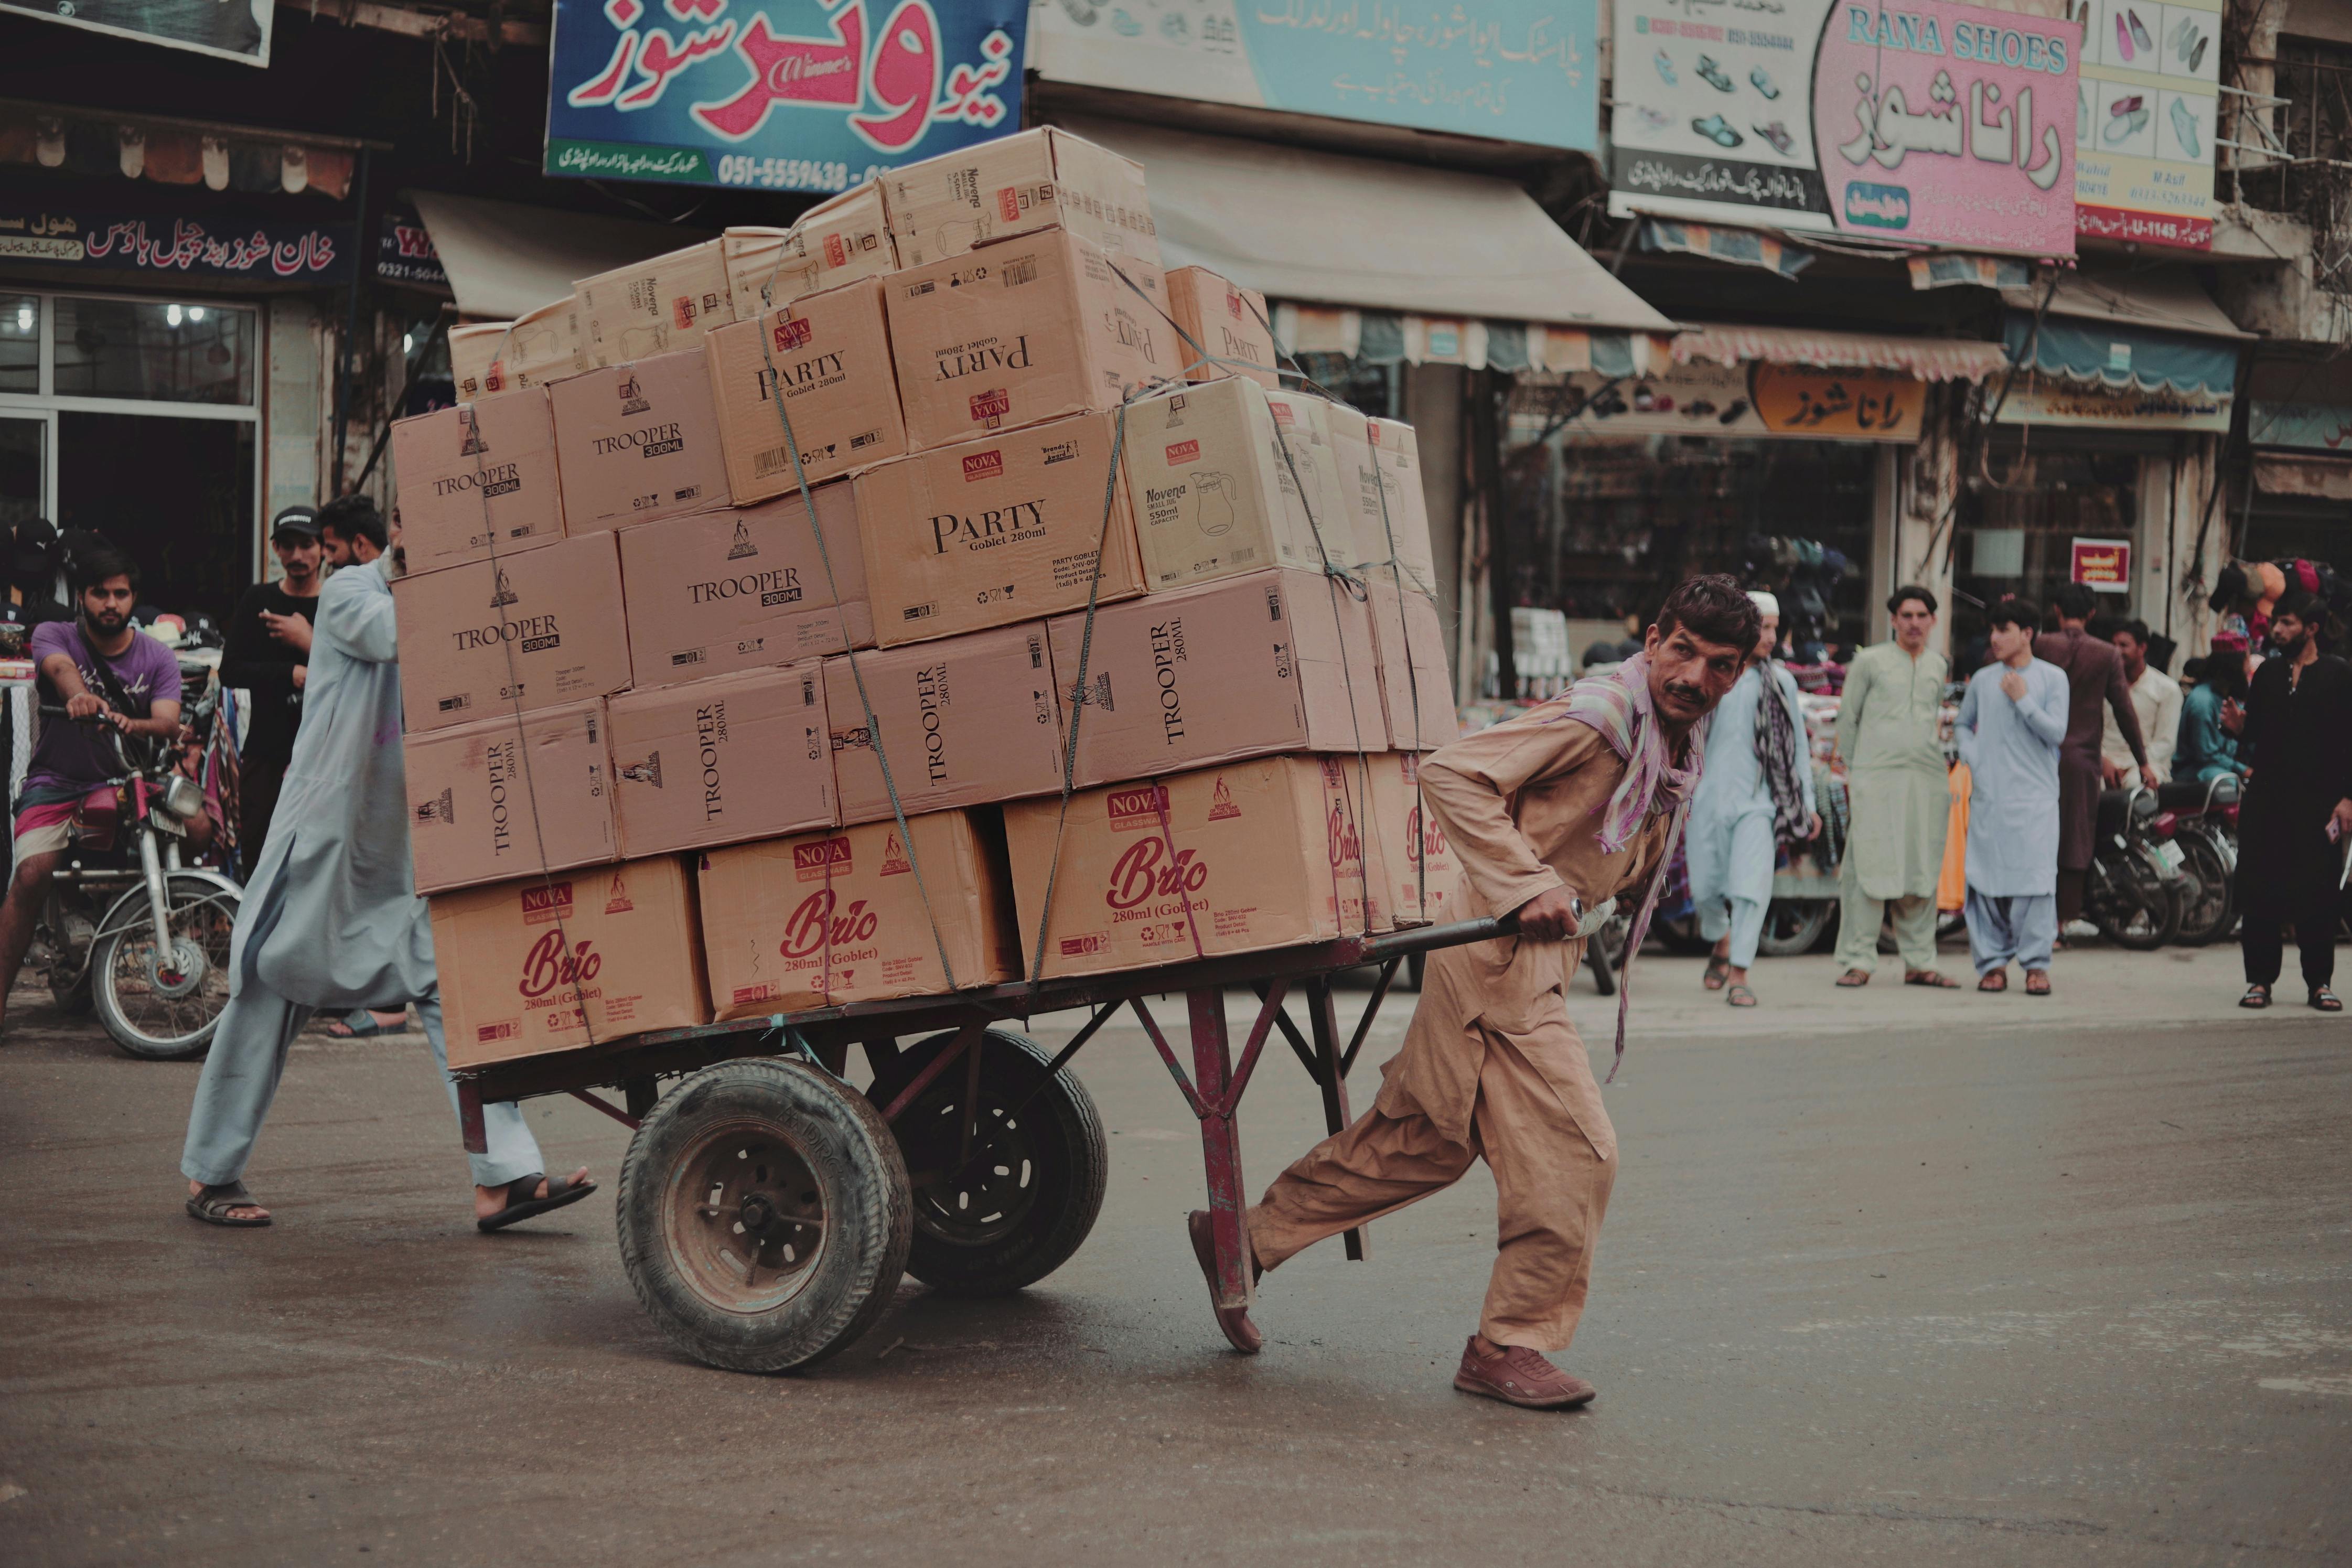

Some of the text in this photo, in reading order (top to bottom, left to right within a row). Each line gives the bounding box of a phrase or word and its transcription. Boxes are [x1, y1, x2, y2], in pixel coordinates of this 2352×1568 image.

[568, 0, 738, 112] شوز
[1848, 7, 1946, 56] RANA
[1954, 24, 2069, 75] SHOES
[768, 54, 854, 92] Winner
[930, 31, 1014, 126] نیو
[1839, 70, 2061, 190] رانا شوز
[966, 167, 982, 208] Novena
[1005, 189, 1016, 220] NOVA
[87, 220, 152, 266] ہاؤس
[150, 218, 205, 270] چپل
[224, 230, 271, 270] شوز
[271, 230, 336, 276] خان
[830, 235, 843, 264] NOVA
[645, 278, 660, 316] Novena
[777, 323, 807, 342] NOVA
[935, 336, 997, 358] Goblet 280ml
[1220, 326, 1260, 362] PARTY
[935, 335, 1033, 382] PARTY
[755, 350, 845, 402] PARTY
[787, 373, 846, 398] Goblet 280ml
[975, 400, 1007, 415] NOVA
[1784, 382, 1904, 429] رانا شوز
[593, 423, 681, 455] TROOPER
[645, 439, 683, 457] 300ML
[1168, 442, 1196, 457] NOVA
[433, 464, 519, 496] TROOPER
[966, 454, 996, 472] NOVA
[485, 478, 520, 498] 300ML
[1146, 485, 1186, 503] Novena
[1147, 498, 1176, 511] SMALL JUG
[928, 499, 1046, 555] PARTY
[1150, 506, 1178, 520] 550ml
[1151, 514, 1179, 525] CAPACITY
[970, 527, 1046, 551] Goblet 280ml
[1053, 550, 1099, 566] PARTY GOBLET
[688, 567, 801, 604] TROOPER
[1055, 572, 1077, 580] Product
[1056, 579, 1072, 589] (1x6)
[763, 588, 802, 606] 300ML
[453, 614, 559, 651] TROOPER
[522, 635, 560, 652] 300ML
[1170, 617, 1187, 662] 280ML
[936, 662, 950, 707] 280ML
[1151, 621, 1185, 745] TROOPER
[715, 700, 728, 743] 280ML
[917, 667, 948, 787] TROOPER
[504, 738, 516, 780] 280ML
[696, 704, 722, 821] TROOPER
[488, 743, 510, 856] TROOPER
[1112, 790, 1158, 815] NOVA
[1329, 806, 1360, 867] Brio
[798, 843, 844, 866] NOVA
[1426, 862, 1449, 873] (Goblet)
[800, 865, 851, 880] GLASSWARE
[1107, 836, 1207, 909] Brio
[525, 889, 567, 909] NOVA
[1112, 906, 1152, 923] 280ml
[780, 888, 877, 959] Brio
[519, 929, 601, 997] Brio
[785, 947, 878, 972] 280ml (Goblet)
[525, 987, 602, 1011] 280ml (Goblet)
